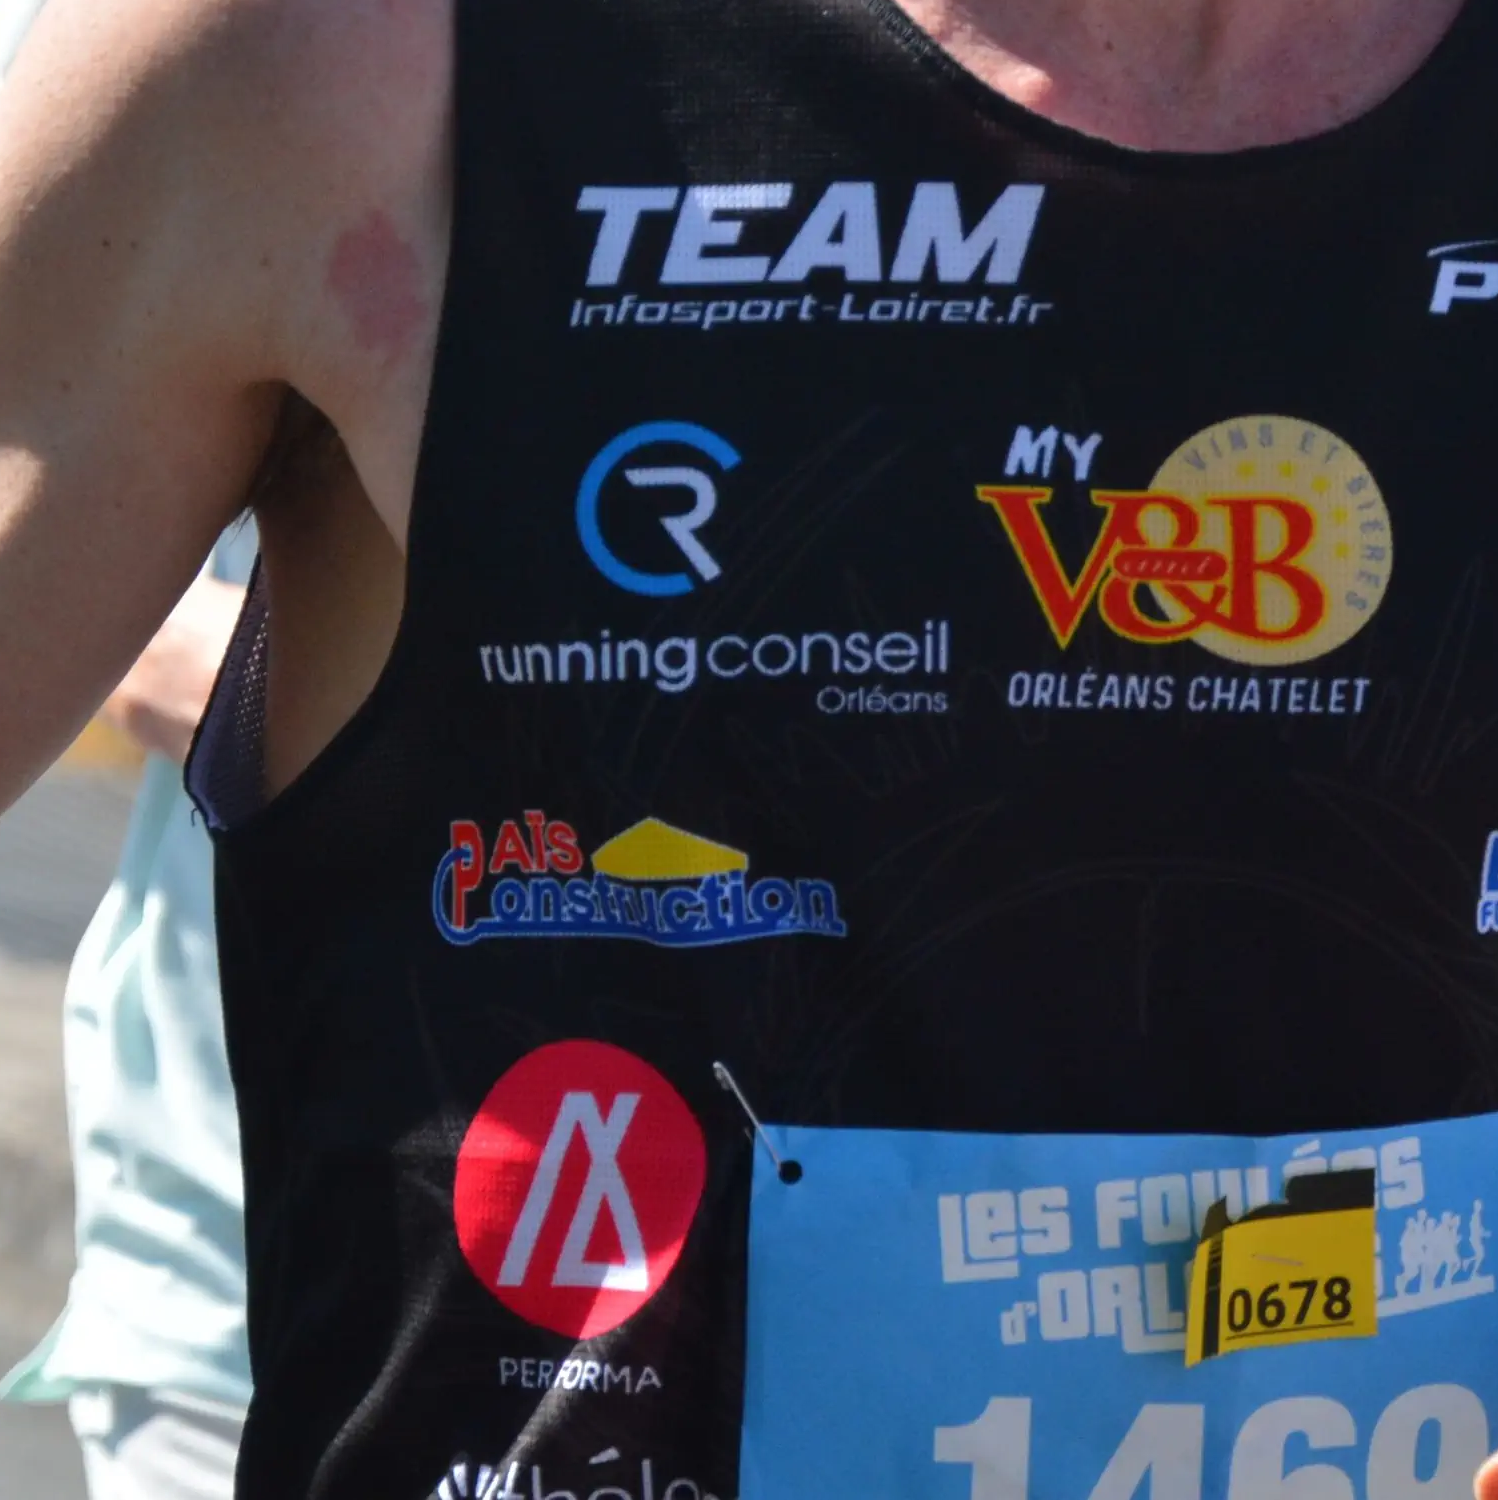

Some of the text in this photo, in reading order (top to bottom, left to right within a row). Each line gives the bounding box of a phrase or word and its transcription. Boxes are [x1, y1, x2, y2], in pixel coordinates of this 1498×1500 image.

[576, 181, 1046, 287] TEAM
[570, 293, 1054, 330] Infosport-Loiret.fr
[1004, 425, 1103, 481] MY
[975, 485, 1329, 650] V&B
[816, 685, 949, 713] Orléans
[1007, 667, 1370, 714] ORLÉANS CHATELET
[1096, 1137, 1424, 1249] FOULS
[1227, 1276, 1352, 1333] 0678
[500, 1358, 661, 1394] PERFORMA
